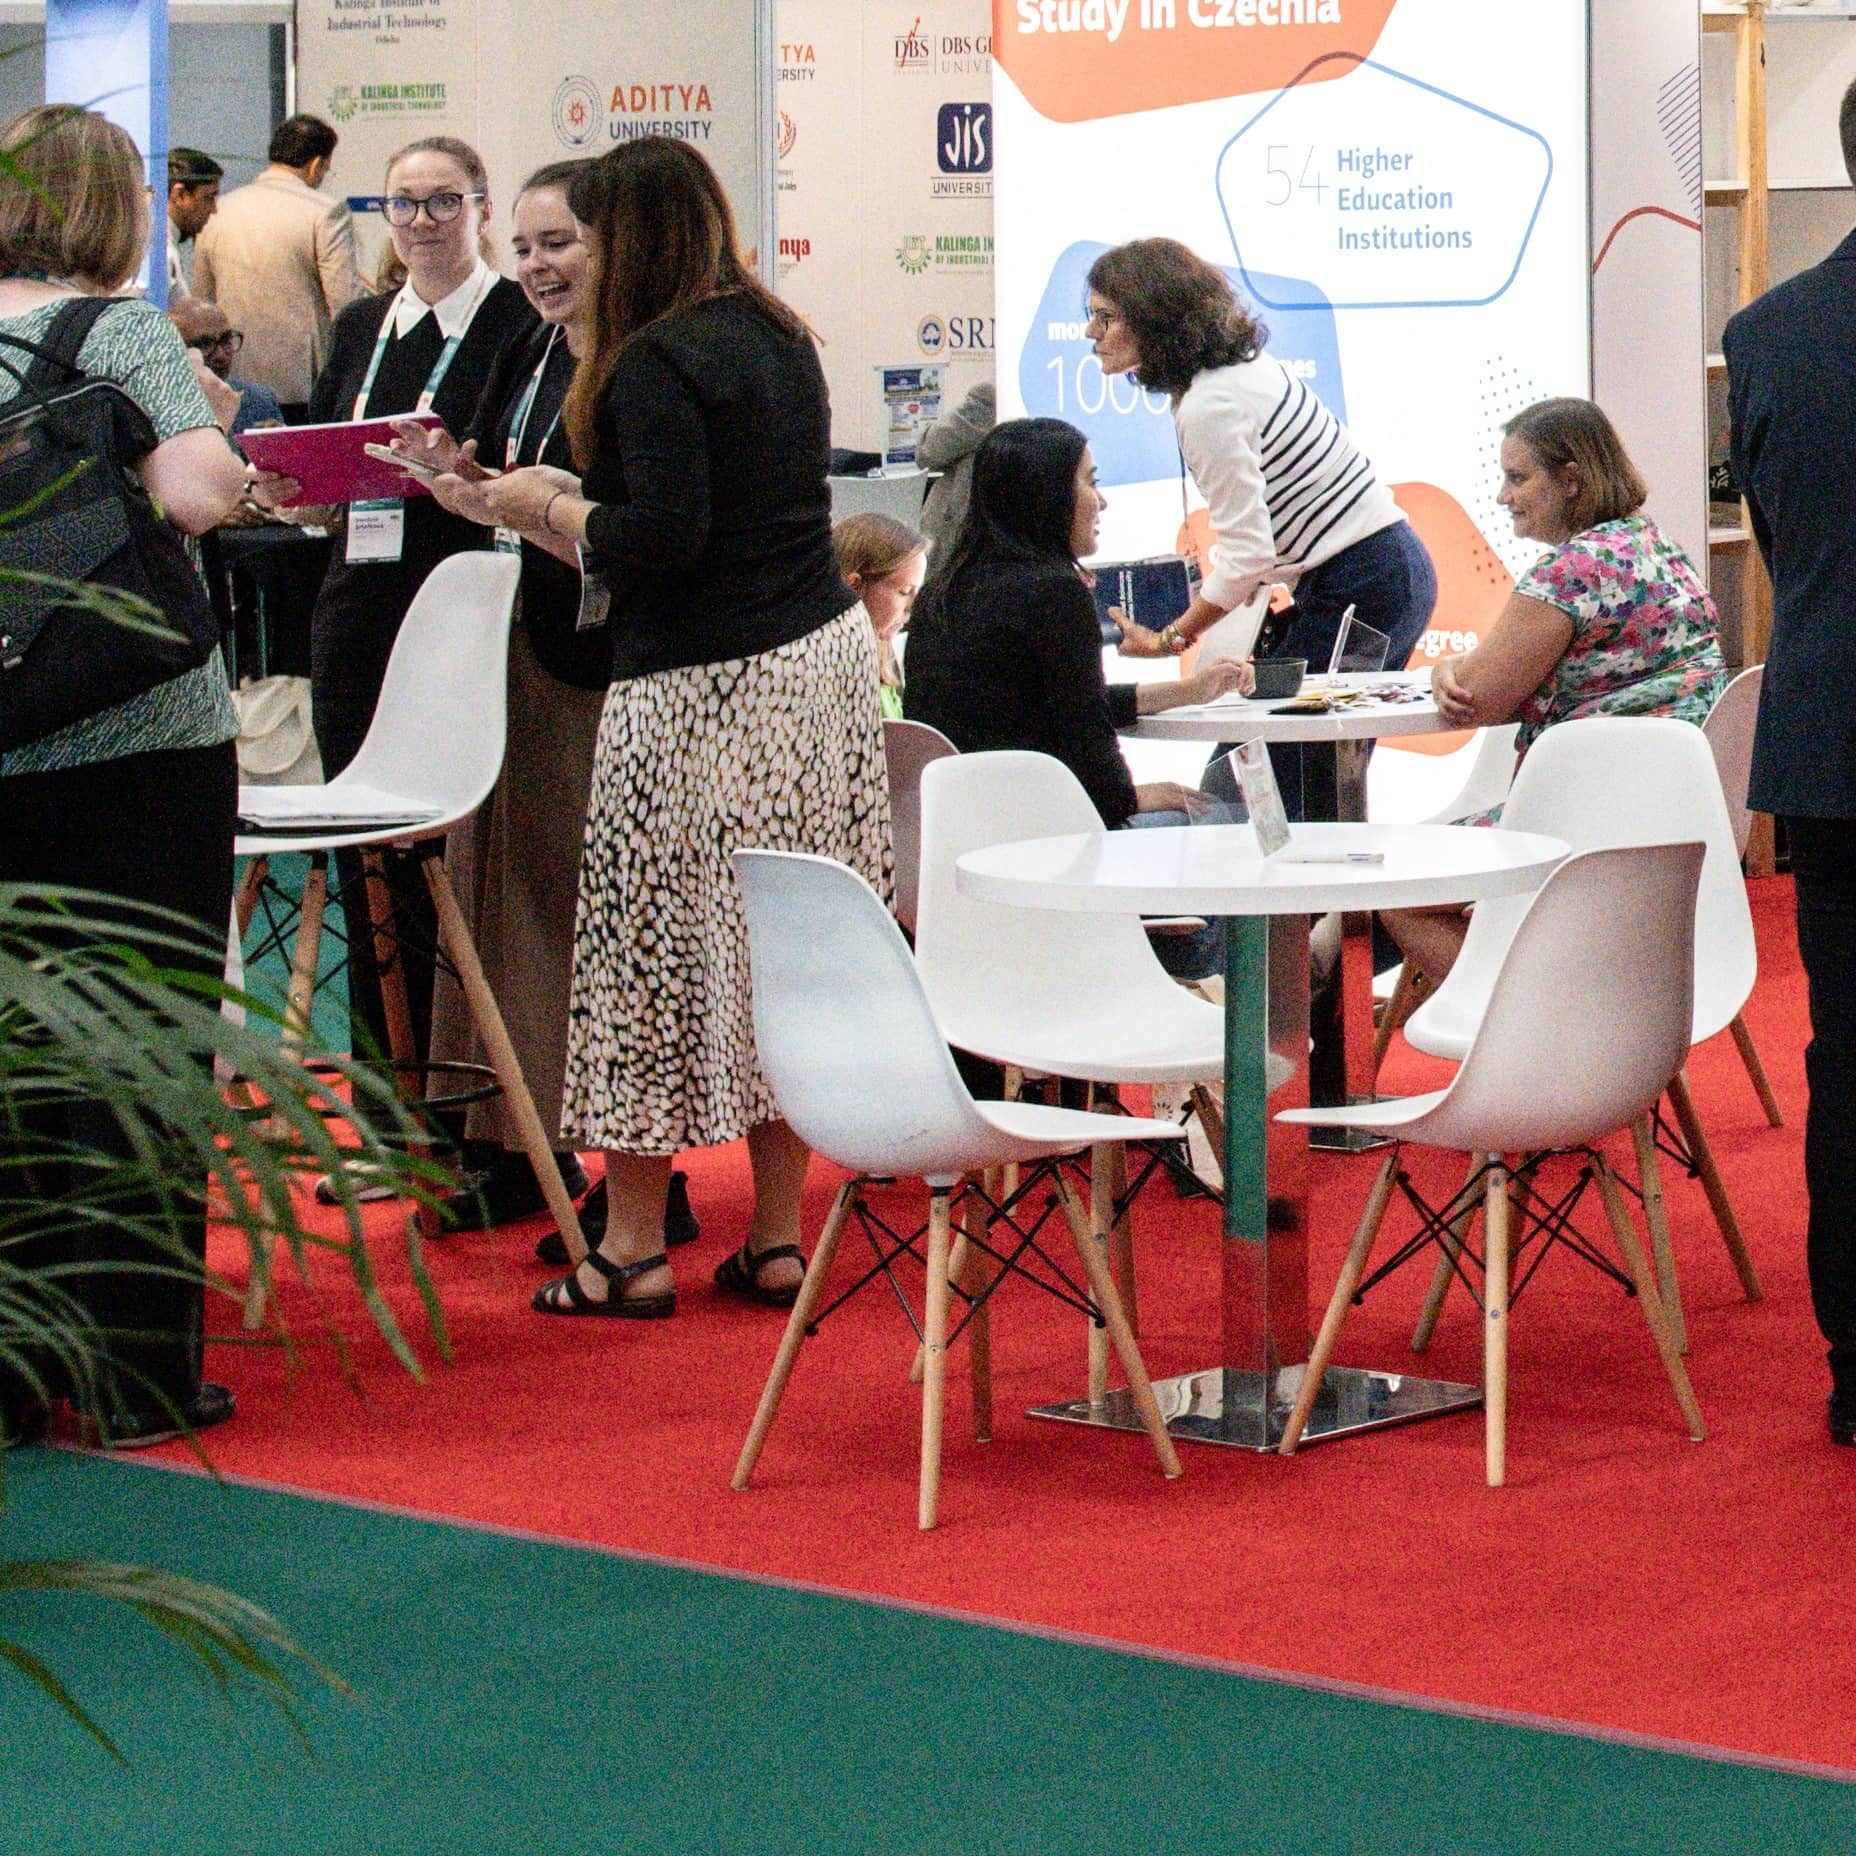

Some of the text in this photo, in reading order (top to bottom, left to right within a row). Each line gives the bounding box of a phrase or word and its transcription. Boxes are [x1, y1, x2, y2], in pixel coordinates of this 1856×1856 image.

[327, 14, 447, 32] Industrial Technology
[895, 39, 929, 58] DBS
[942, 37, 972, 55] DBS
[361, 83, 446, 100] KALINGA INSTITUTE
[610, 84, 713, 113] ADITYA
[609, 120, 712, 141] UNIVERSITY
[1265, 144, 1414, 206] 54 Higher
[1337, 185, 1453, 211] Education
[936, 235, 981, 252] KALINGA
[1338, 224, 1473, 250] Institutions
